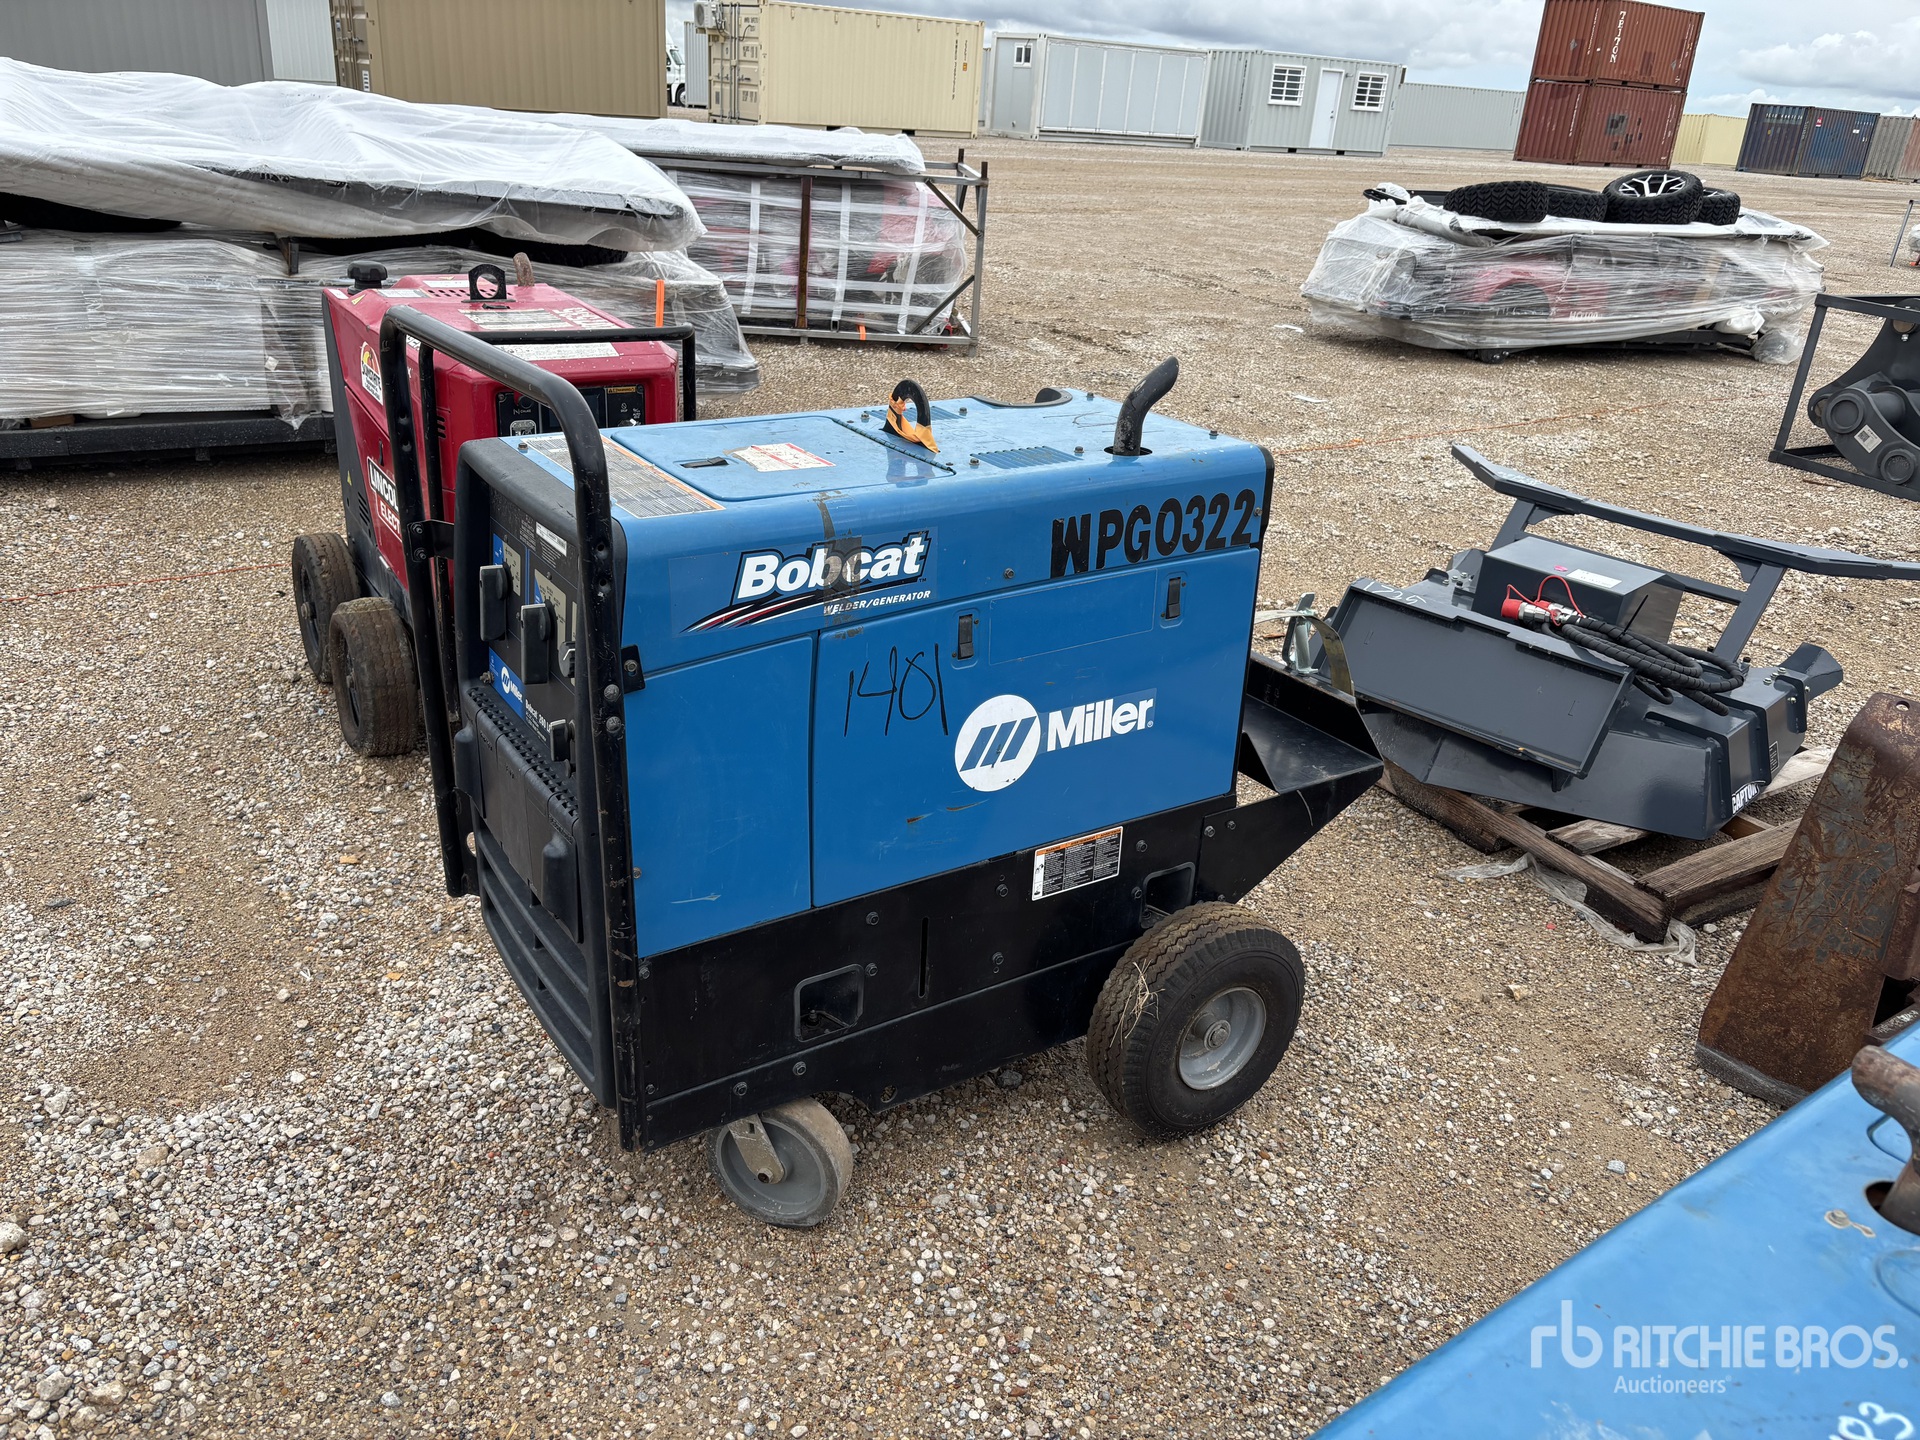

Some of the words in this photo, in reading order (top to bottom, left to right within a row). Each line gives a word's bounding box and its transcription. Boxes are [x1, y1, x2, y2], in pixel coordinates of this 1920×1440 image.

[1610, 10, 1627, 63] TRITON
[369, 464, 399, 511] LINCOL
[380, 500, 400, 534] ELECT
[737, 535, 925, 599] Bobcat
[824, 589, 932, 615] WELDER/GENERATOR
[844, 642, 949, 737] 1401
[1047, 697, 1155, 752] Miller
